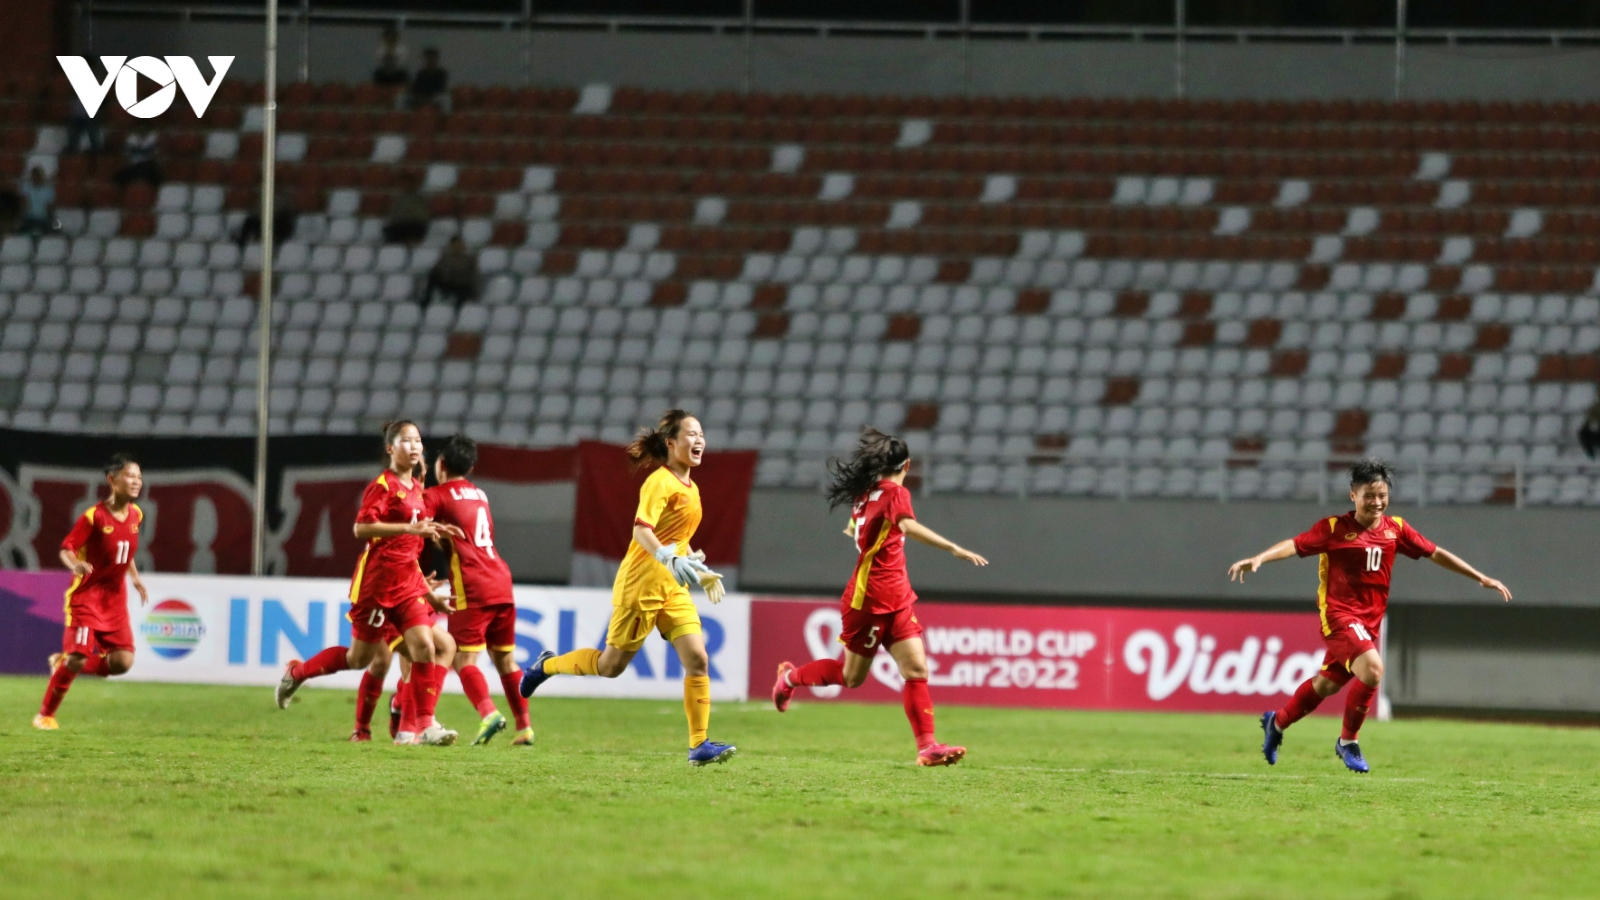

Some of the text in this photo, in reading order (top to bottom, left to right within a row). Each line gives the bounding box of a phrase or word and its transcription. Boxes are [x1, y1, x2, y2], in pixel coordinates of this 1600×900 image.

[474, 506, 496, 559] 4
[115, 540, 130, 565] 11
[1365, 547, 1382, 572] 10
[368, 608, 386, 628] 15
[631, 616, 642, 641] 1
[75, 625, 90, 646] 11
[863, 626, 880, 648] 5
[926, 626, 1097, 659] WORLD CUP
